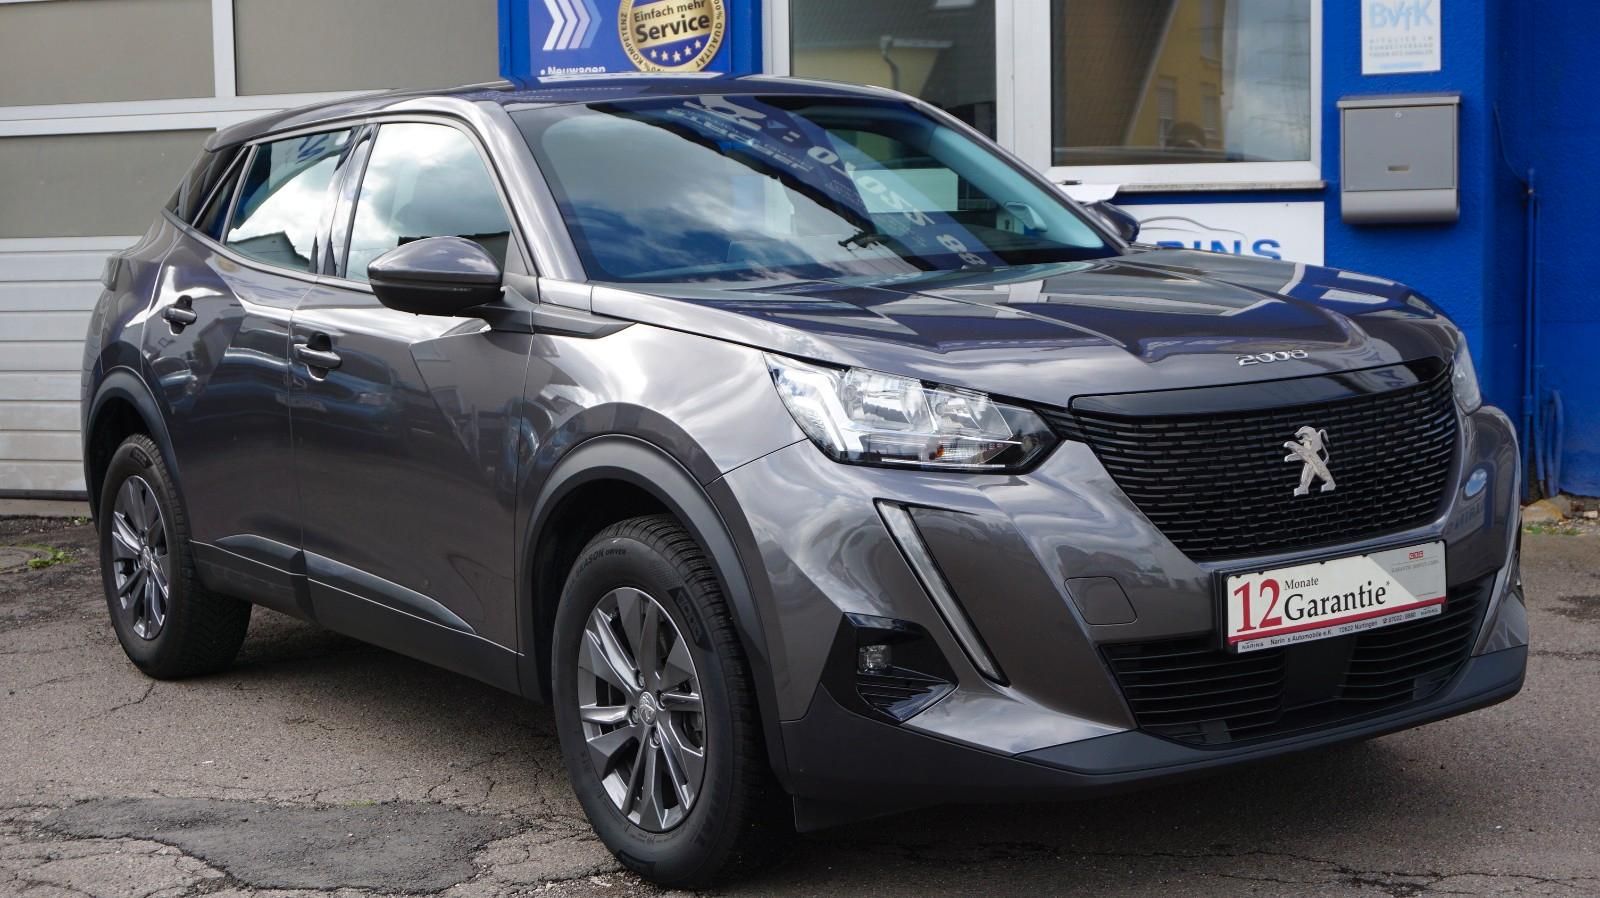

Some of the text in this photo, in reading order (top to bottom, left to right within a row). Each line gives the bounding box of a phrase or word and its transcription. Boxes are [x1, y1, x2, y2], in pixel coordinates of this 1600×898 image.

[634, 0, 705, 23] Einfach mehr
[635, 14, 711, 44] Service
[1235, 349, 1309, 366] 2008
[1233, 576, 1319, 633] 12 Monate
